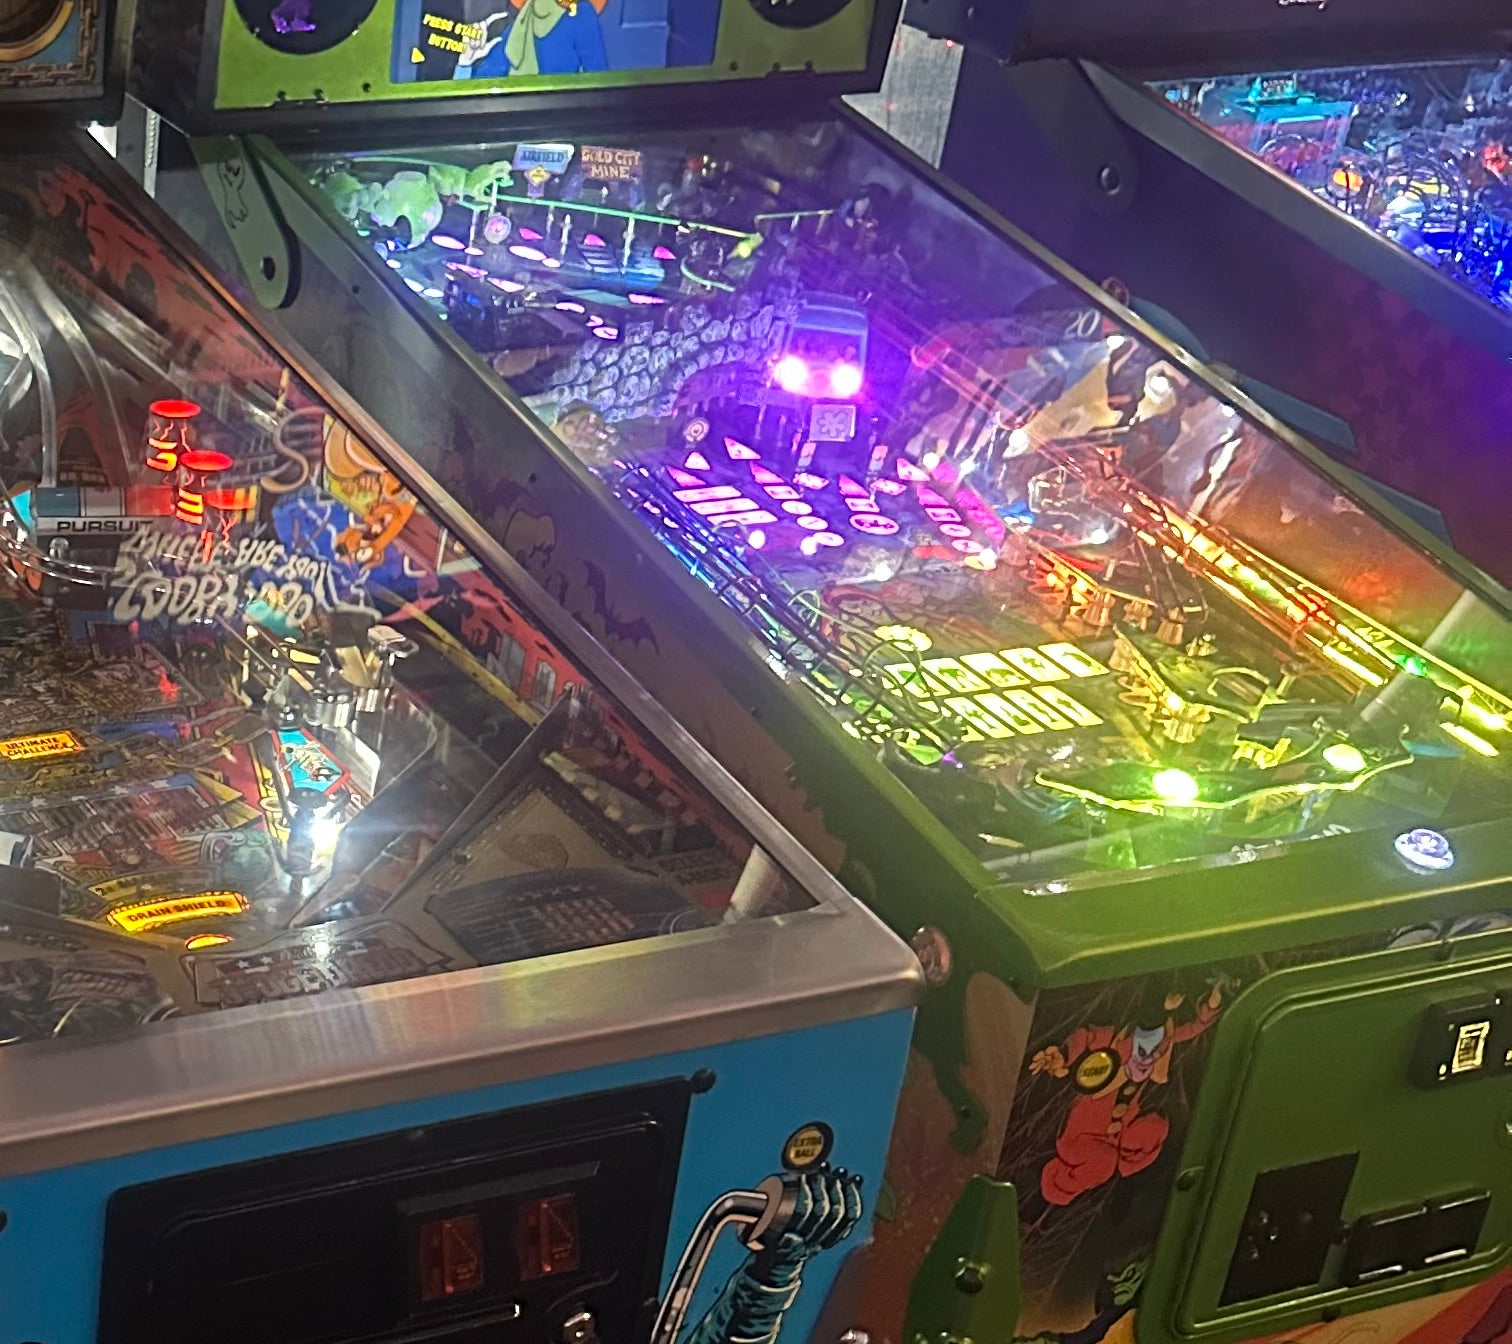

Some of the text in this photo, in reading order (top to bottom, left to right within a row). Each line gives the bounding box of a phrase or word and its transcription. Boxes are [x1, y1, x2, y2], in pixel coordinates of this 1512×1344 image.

[568, 2, 578, 17] 3
[422, 13, 483, 41] PRESS START
[520, 150, 565, 163] AIRFIELD
[581, 149, 641, 166] GOLD CITY
[590, 165, 631, 179] MINE
[56, 520, 154, 533] PURSUIT
[5, 737, 60, 750] ULTIMATE
[7, 742, 71, 757] CHALLENGE
[127, 900, 227, 923] DRAIN SHIELD
[1080, 1064, 1110, 1079] START
[793, 1135, 822, 1148] EXTRA
[794, 1148, 816, 1159] BALL
